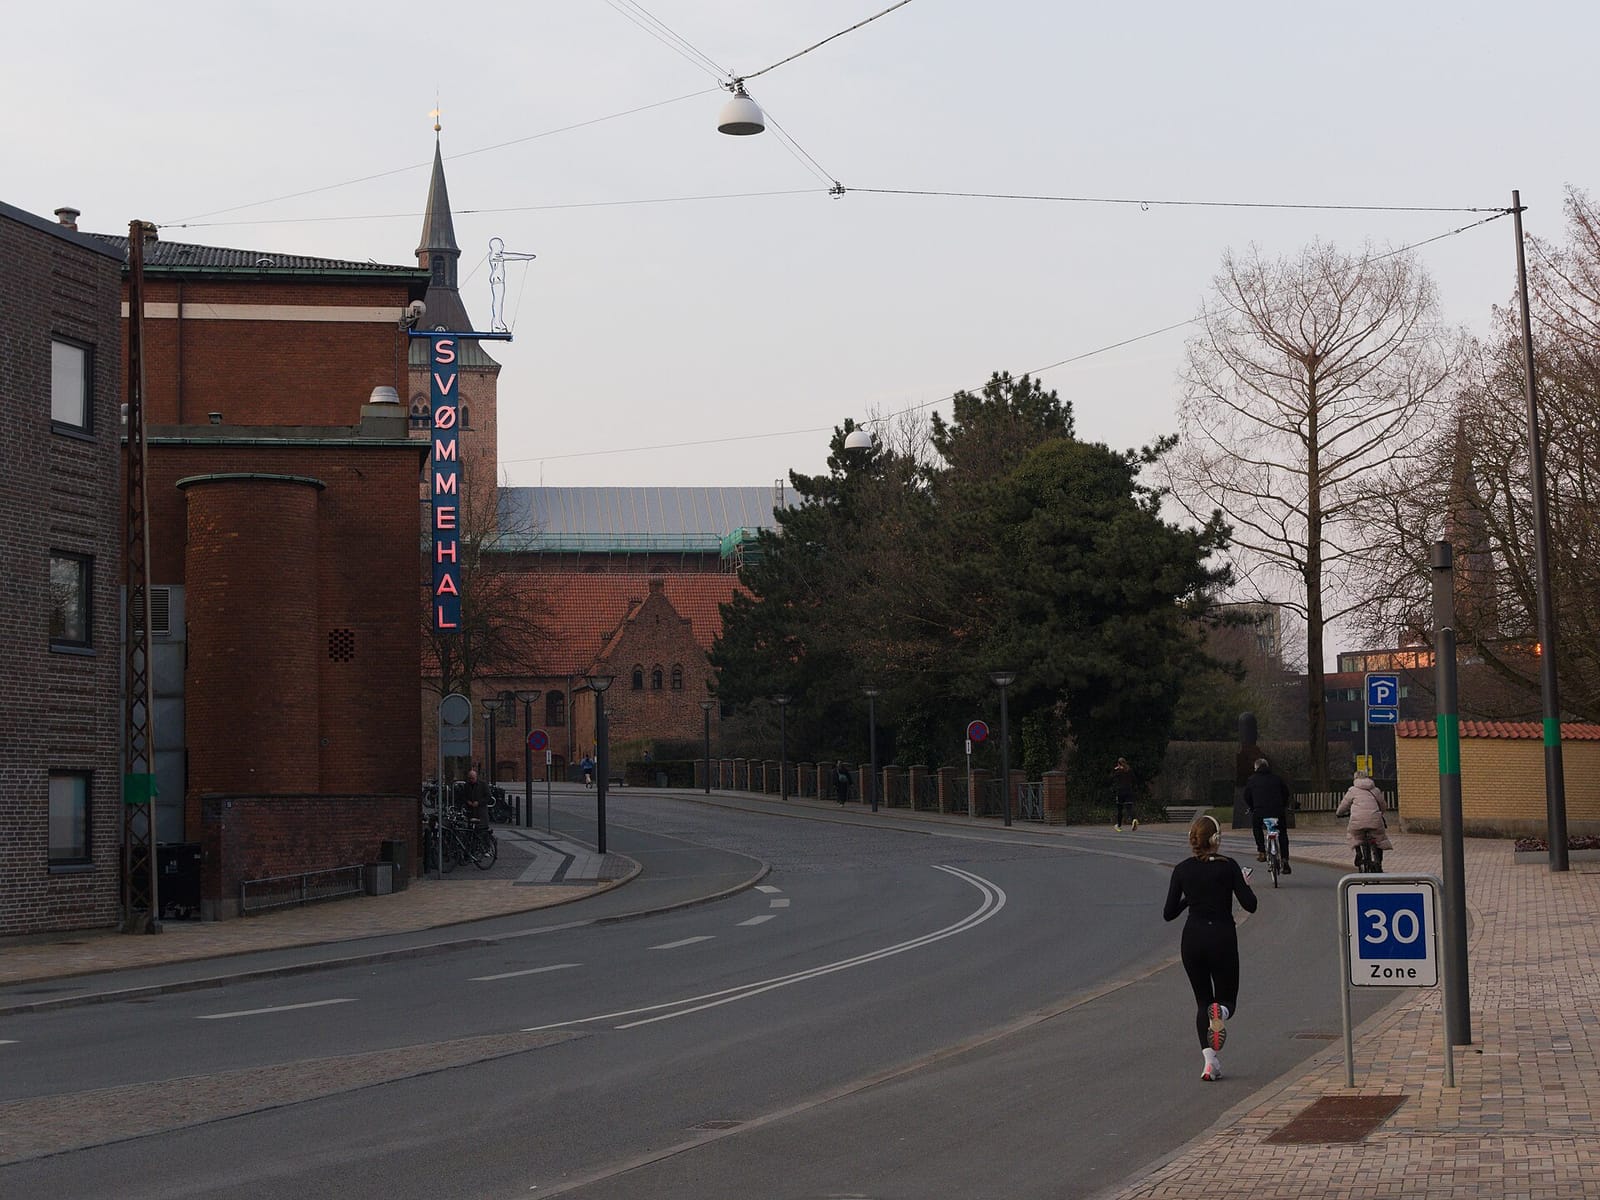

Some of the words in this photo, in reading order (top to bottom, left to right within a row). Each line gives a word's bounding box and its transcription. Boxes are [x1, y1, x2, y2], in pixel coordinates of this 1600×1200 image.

[434, 339, 459, 628] SVØMMEHAL
[1377, 686, 1390, 704] P
[1364, 908, 1420, 944] 30
[1370, 964, 1417, 978] Zone
